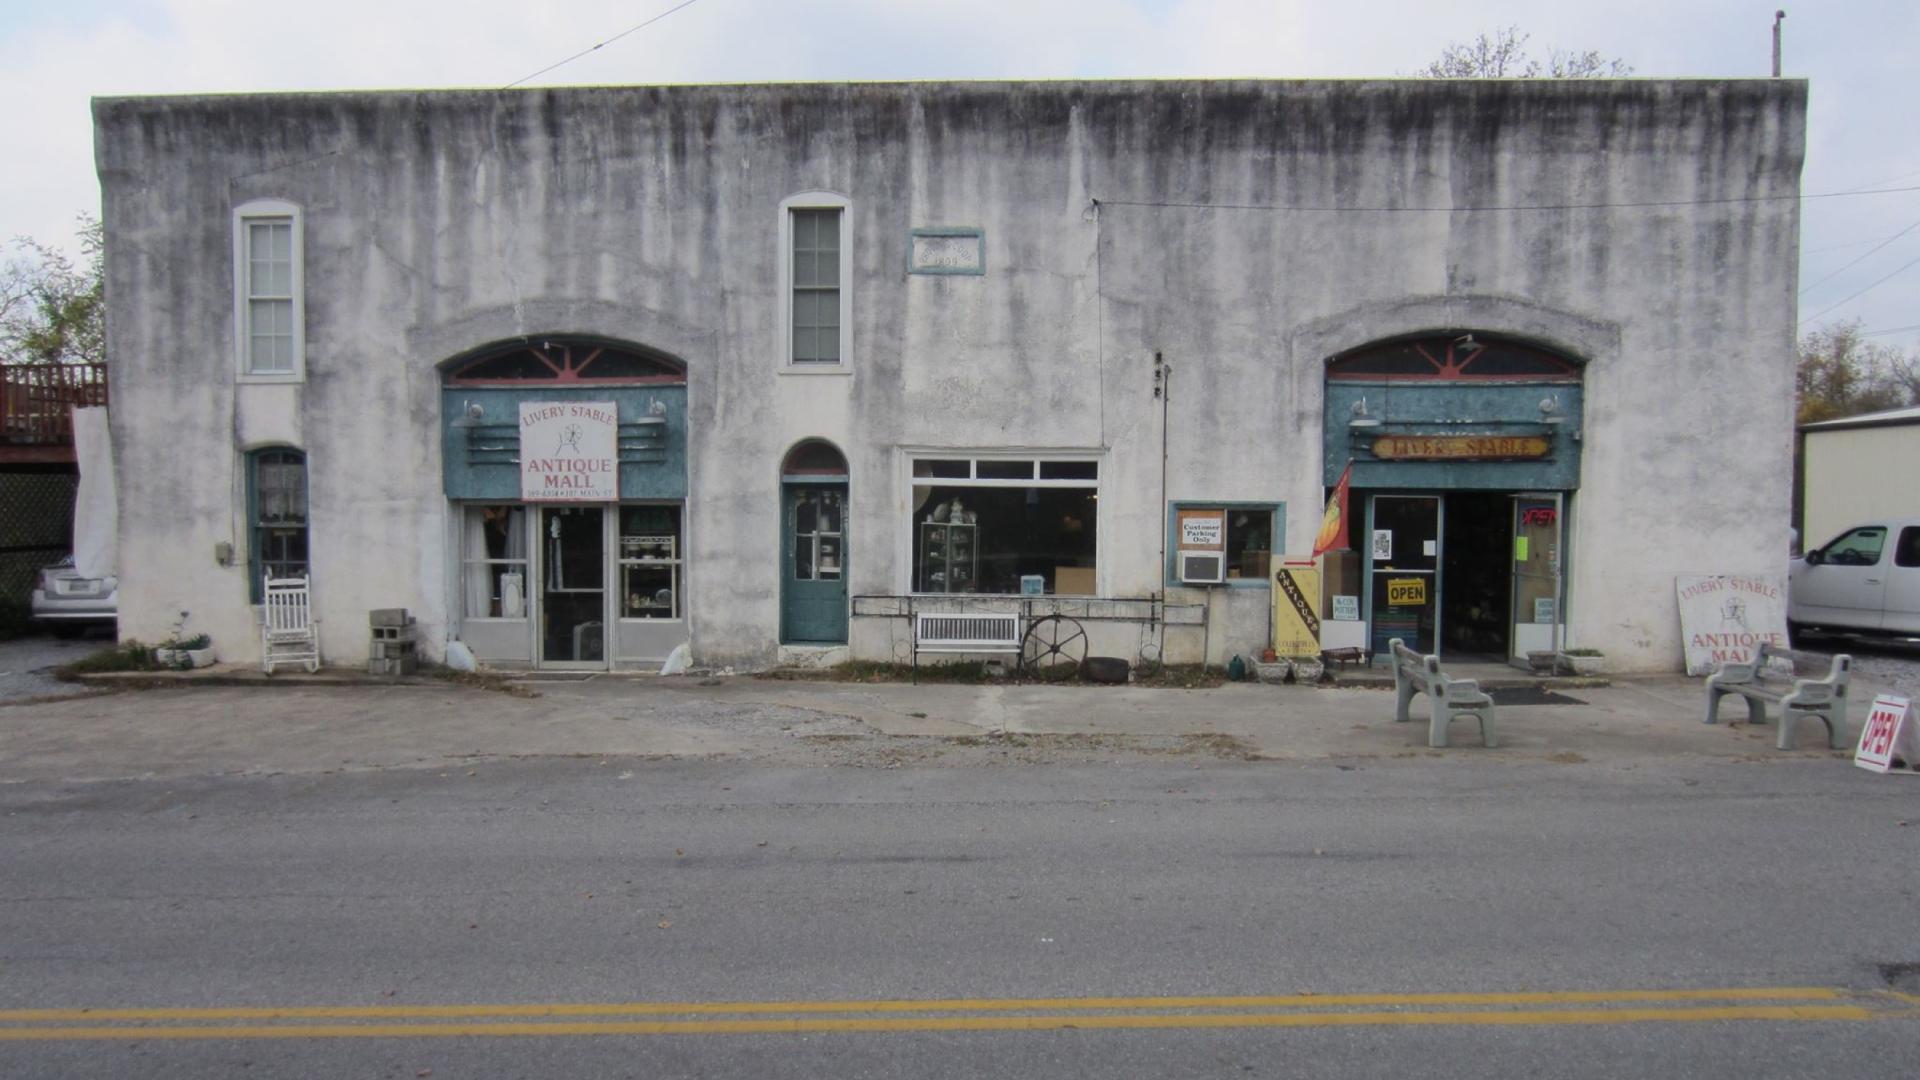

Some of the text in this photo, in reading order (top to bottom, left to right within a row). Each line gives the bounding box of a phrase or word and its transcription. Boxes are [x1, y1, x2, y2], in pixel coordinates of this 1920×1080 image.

[522, 406, 615, 426] LIVERY STABLE
[1393, 438, 1530, 458] LIVER STABLE
[527, 458, 612, 475] ANTIQUE
[544, 475, 595, 488] MALL
[1183, 523, 1220, 531] Customer
[1187, 530, 1217, 538] Parking
[1391, 585, 1424, 600] OPEN
[1681, 578, 1777, 600] LIVERY STABLE
[1279, 571, 1319, 632] ANTIQUES
[1711, 649, 1752, 663] MAL
[1862, 710, 1901, 756] OPEN
